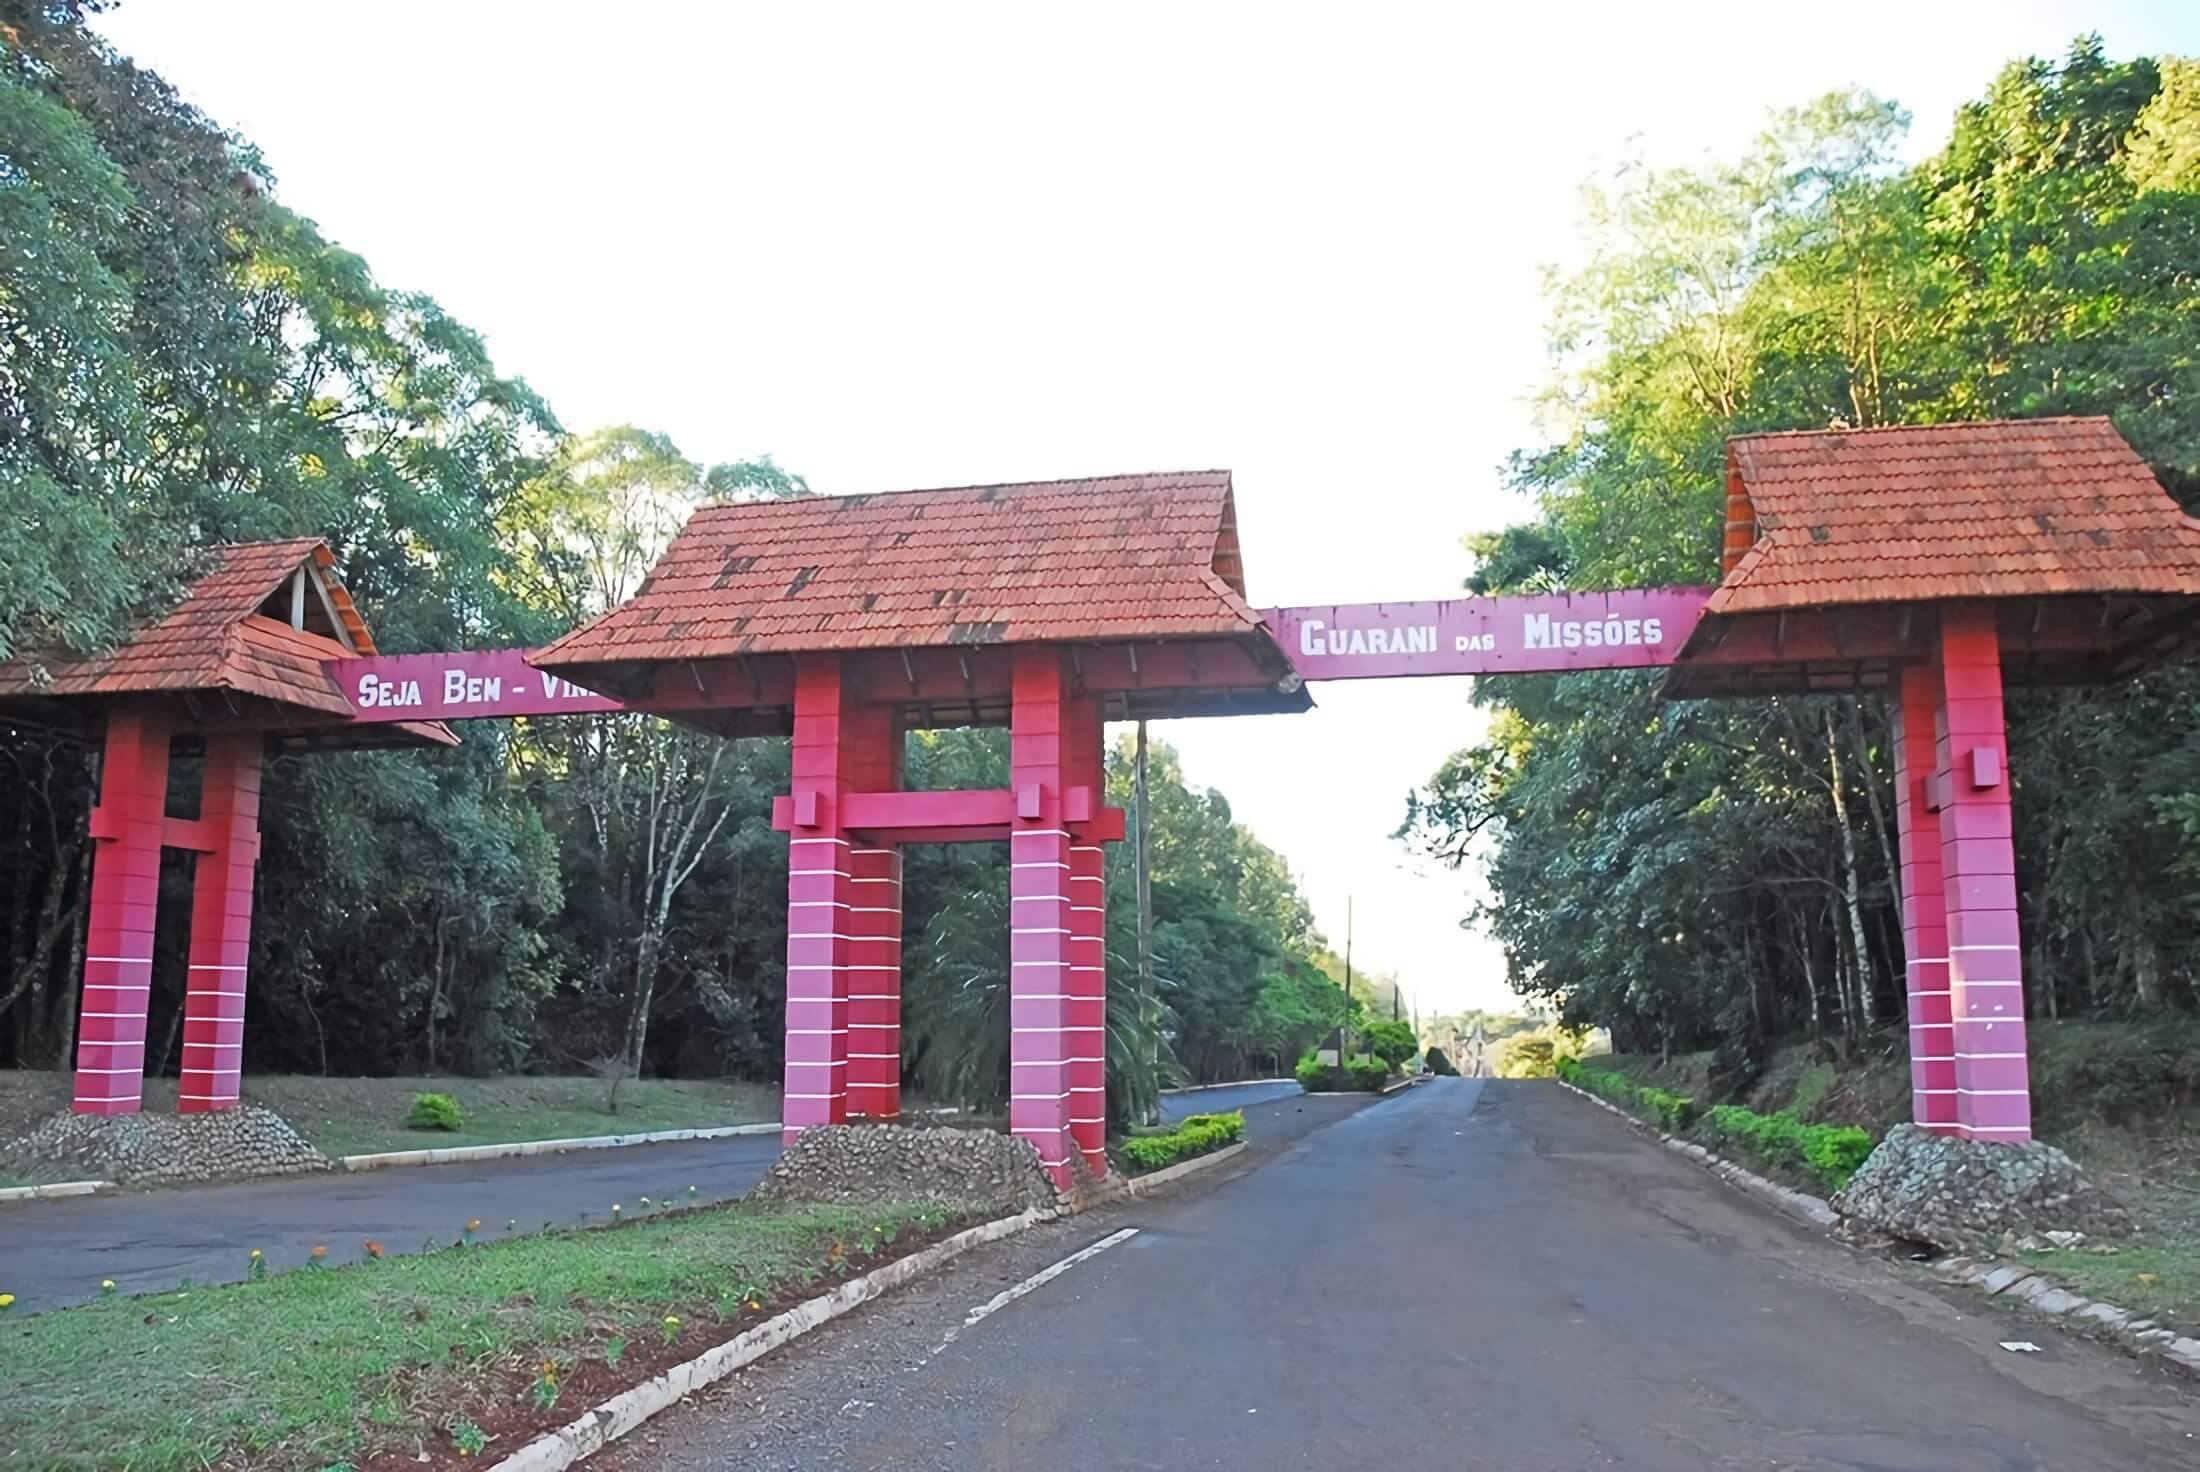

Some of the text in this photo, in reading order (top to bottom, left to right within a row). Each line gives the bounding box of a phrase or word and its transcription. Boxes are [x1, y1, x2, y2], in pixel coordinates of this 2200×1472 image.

[1301, 612, 1663, 656] GUARANI DAS MISSÕES
[358, 674, 422, 708] SEJA
